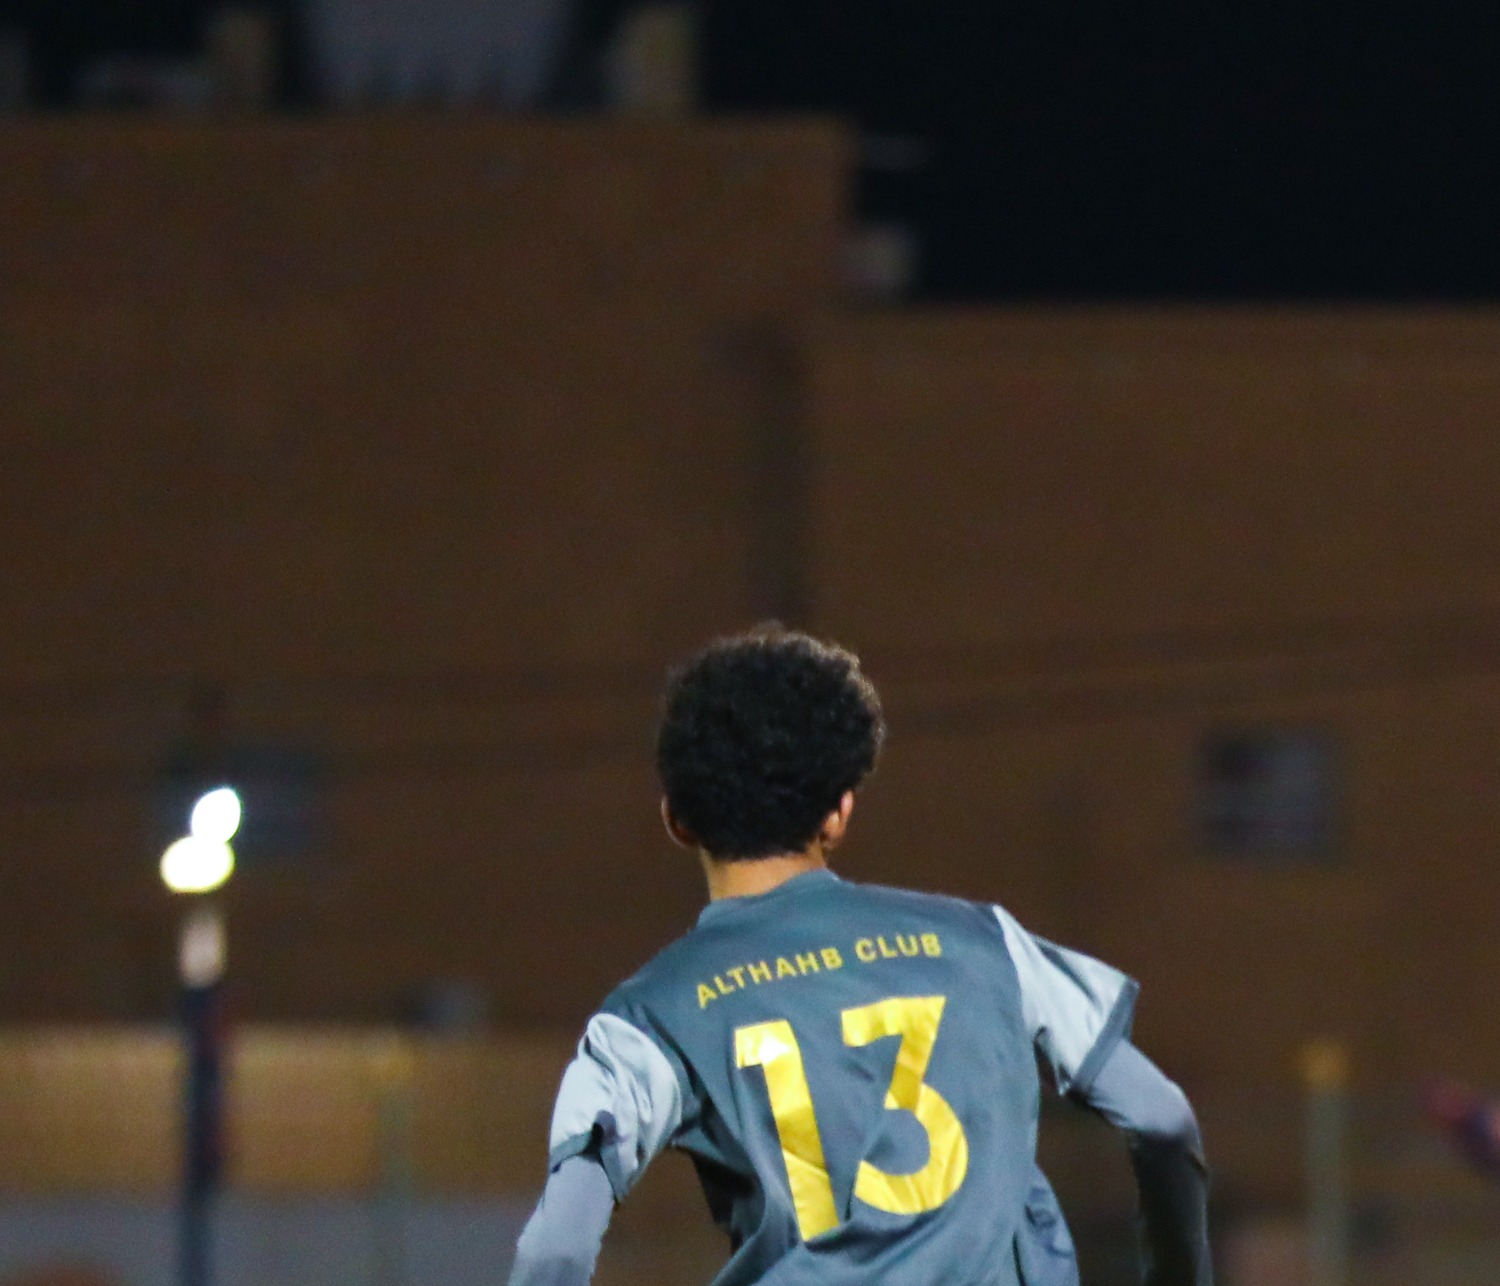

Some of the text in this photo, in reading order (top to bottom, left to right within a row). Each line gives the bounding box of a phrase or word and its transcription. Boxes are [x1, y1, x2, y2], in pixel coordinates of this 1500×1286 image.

[695, 933, 942, 1009] ALTHAHB CLUB
[734, 996, 969, 1242] 13
